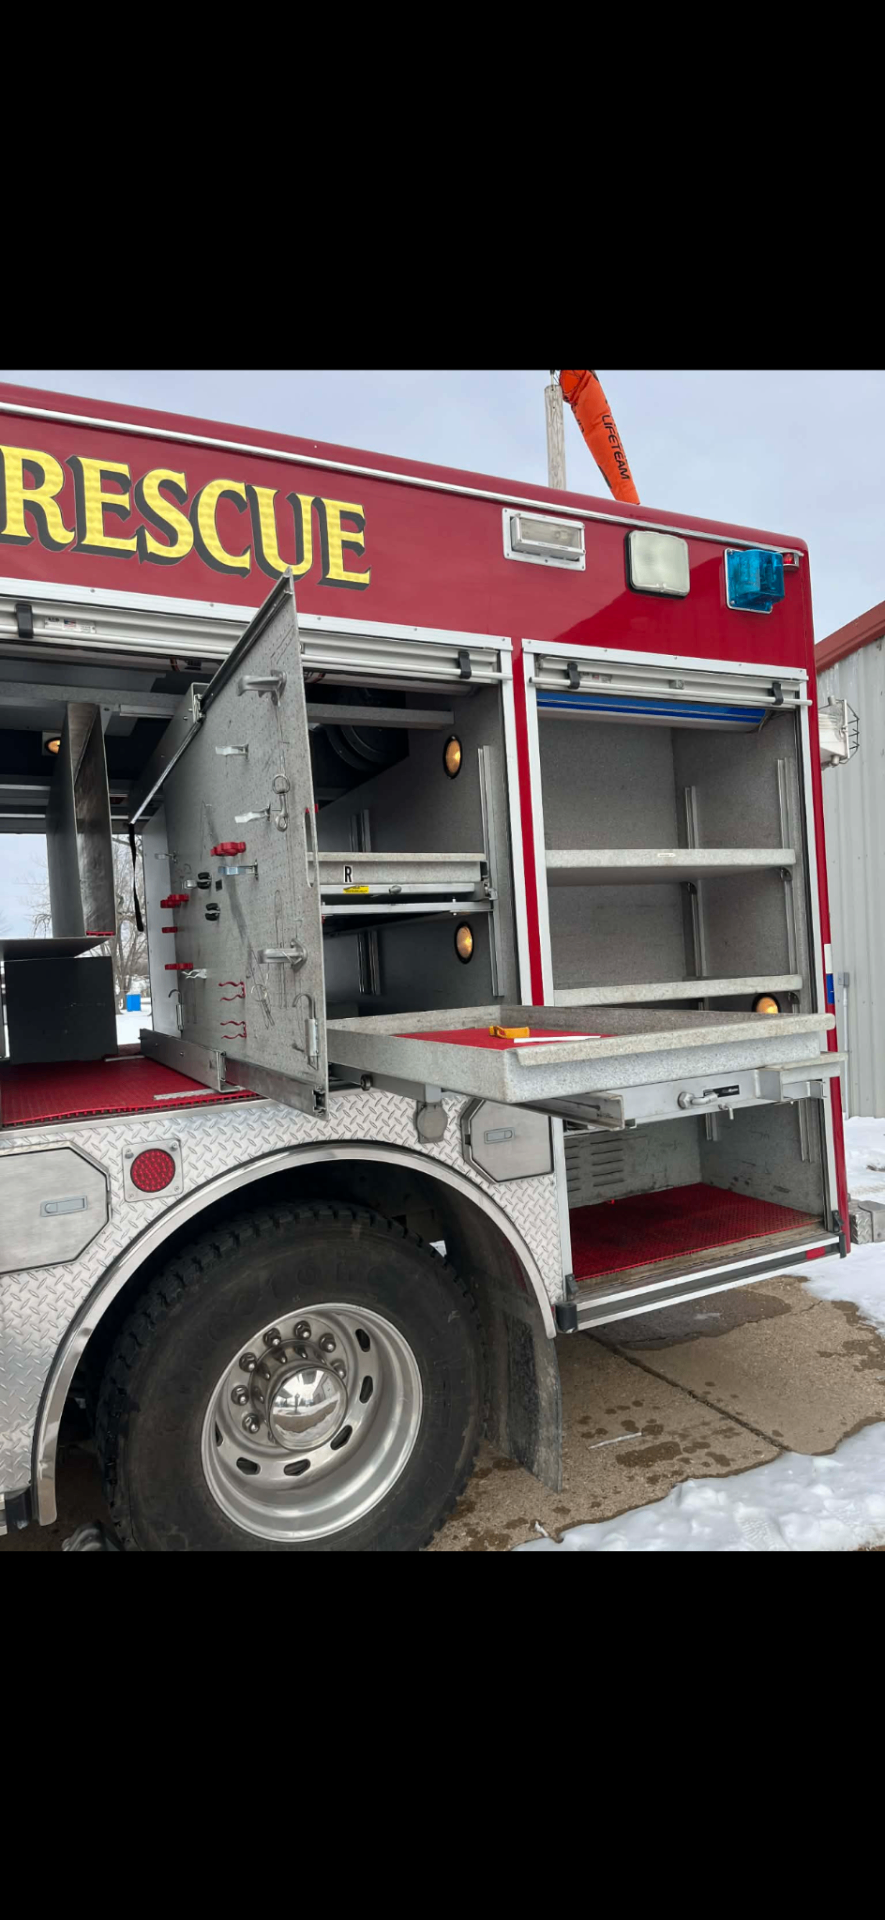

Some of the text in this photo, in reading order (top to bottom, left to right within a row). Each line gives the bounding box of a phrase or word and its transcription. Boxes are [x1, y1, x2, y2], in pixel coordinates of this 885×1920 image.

[601, 414, 631, 480] LIFETEAM
[0, 445, 371, 590] RESCUE
[344, 865, 352, 883] R
